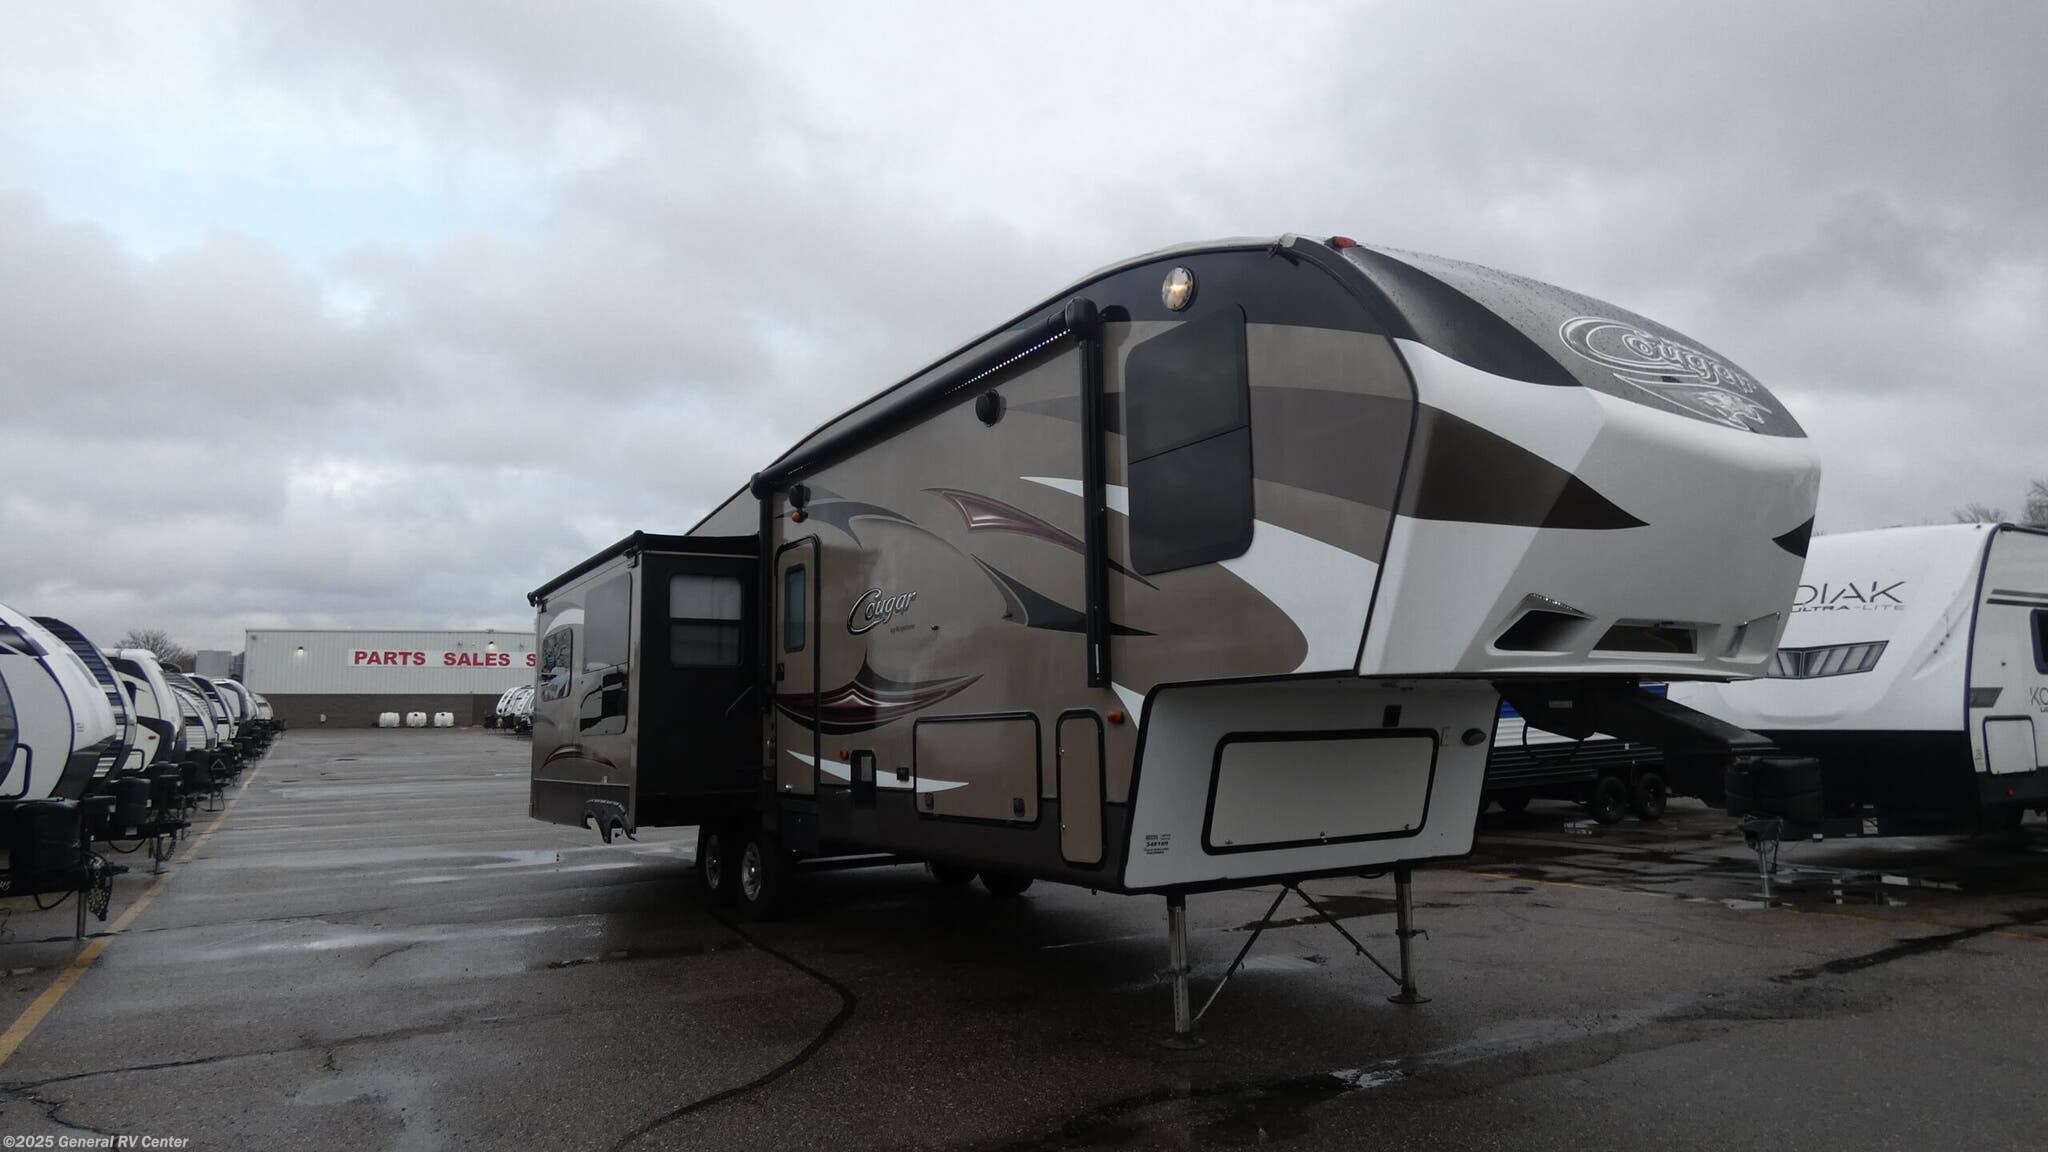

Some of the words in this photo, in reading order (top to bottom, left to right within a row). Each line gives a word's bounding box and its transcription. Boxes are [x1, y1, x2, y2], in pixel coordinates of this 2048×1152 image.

[1558, 316, 1757, 394] Cougar
[847, 588, 917, 635] Cougar
[354, 651, 426, 666] PARTS
[443, 652, 511, 667] SALES
